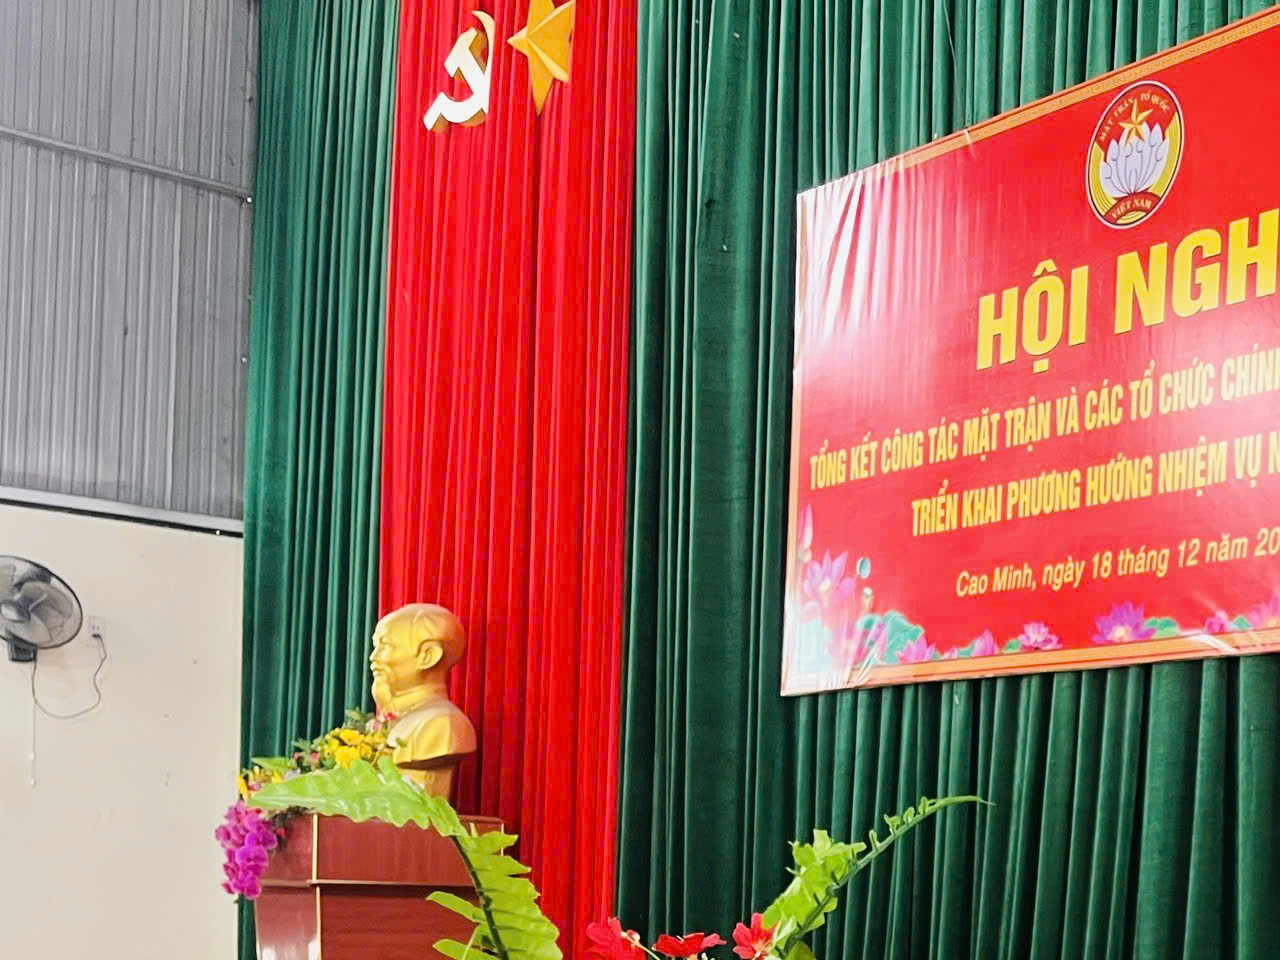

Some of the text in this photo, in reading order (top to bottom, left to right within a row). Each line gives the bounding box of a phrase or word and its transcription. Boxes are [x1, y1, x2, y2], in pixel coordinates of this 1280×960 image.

[977, 258, 1089, 374] HỘI
[810, 439, 847, 490] TỔNG
[850, 431, 878, 481] KẾT
[881, 428, 924, 474] CÔNG
[928, 417, 959, 463] TÁC
[963, 407, 1000, 462] MẶT
[1004, 396, 1051, 452] TRẬN
[1056, 386, 1079, 437] VÀ
[1084, 378, 1124, 430] CÁC
[1129, 360, 1155, 421] TỔ
[1158, 357, 1215, 415] CHỨC
[912, 479, 959, 537] TRIỂN
[962, 484, 1003, 528] KHAI
[1006, 469, 1081, 520] PHƯƠNG
[1086, 452, 1153, 507] HƯỚNG
[1158, 435, 1228, 497] NHIỆM
[1234, 433, 1262, 488] VỤ
[956, 571, 988, 598] Cao
[992, 564, 1036, 592] Minh,
[1042, 556, 1085, 591] ngày
[1091, 551, 1113, 579] 18
[1117, 547, 1169, 578] tháng
[1177, 538, 1201, 568] 12
[1204, 533, 1248, 564] năm
